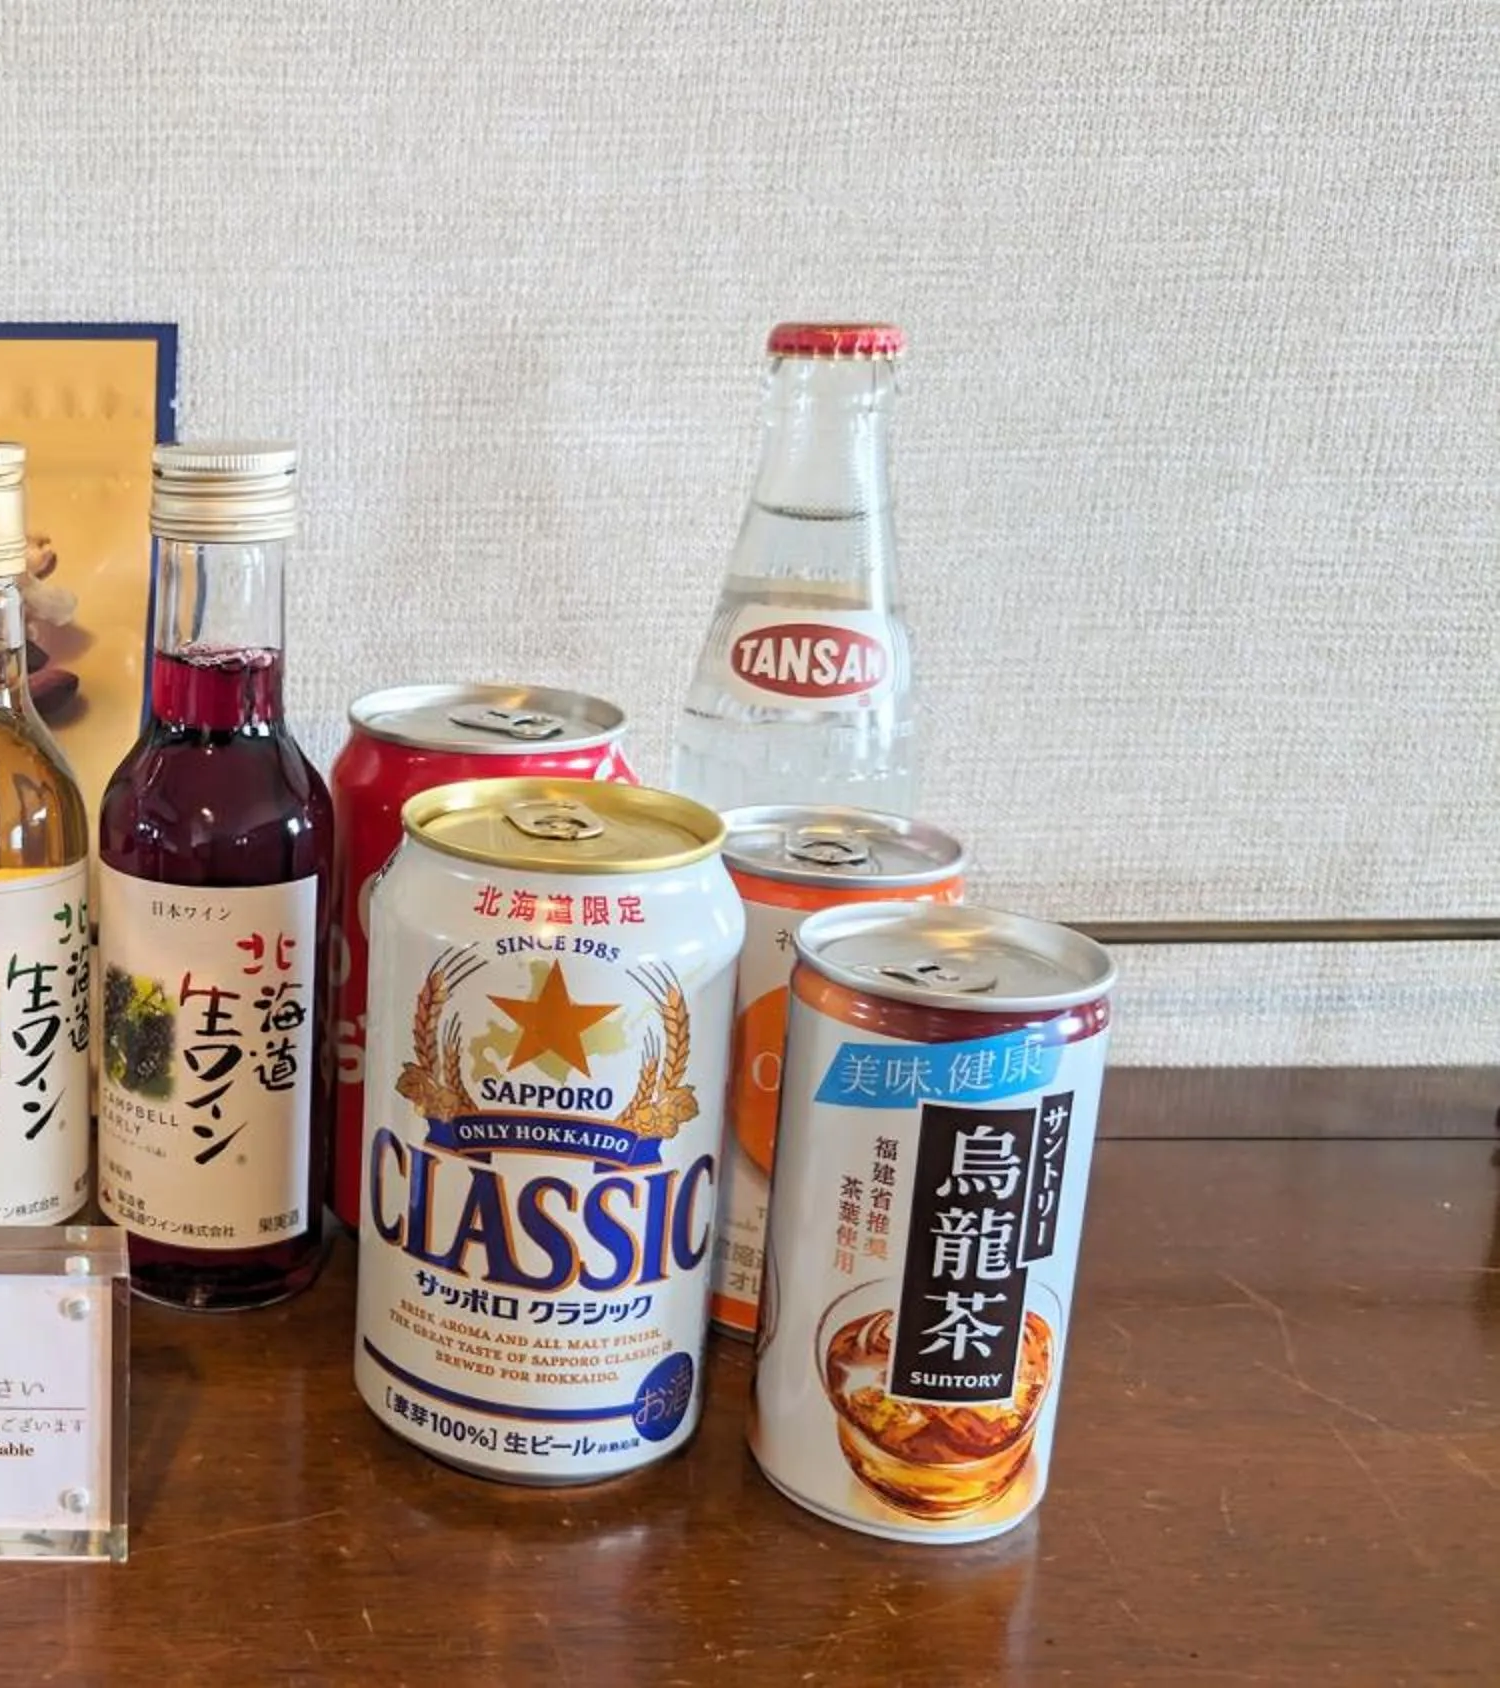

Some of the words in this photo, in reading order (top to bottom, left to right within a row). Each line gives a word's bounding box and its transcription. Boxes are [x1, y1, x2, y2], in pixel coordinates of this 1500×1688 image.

[739, 636, 881, 686] TANSAN
[151, 898, 232, 922] 日本ワイン
[473, 885, 646, 927] 北海道限定
[573, 937, 621, 963] 1985
[235, 931, 307, 1092] 北海道
[179, 971, 248, 1165] 生ワイン
[841, 1034, 1045, 1097] 美味、健康
[481, 1077, 614, 1110] SAPPORO
[459, 1124, 509, 1141] ONLY
[515, 1125, 629, 1153] HOKKAIDO
[1037, 1106, 1068, 1246] サントリー
[371, 1128, 713, 1291] CLASSIC
[415, 1269, 518, 1321] サッポロ
[528, 1295, 653, 1325] クラシック
[412, 1322, 454, 1348] GREAT
[457, 1340, 502, 1361] TASTE
[506, 1352, 527, 1365] OF
[531, 1355, 600, 1367] SAPPORO
[439, 1317, 491, 1341] AROMA
[495, 1333, 528, 1347] AND
[532, 1338, 561, 1349] ALL
[567, 1338, 609, 1350] MALT
[435, 1350, 495, 1376] BREWED
[499, 1368, 529, 1382] FOR
[910, 1371, 1002, 1389] SUNTORY
[503, 1431, 595, 1457] 生ビール
